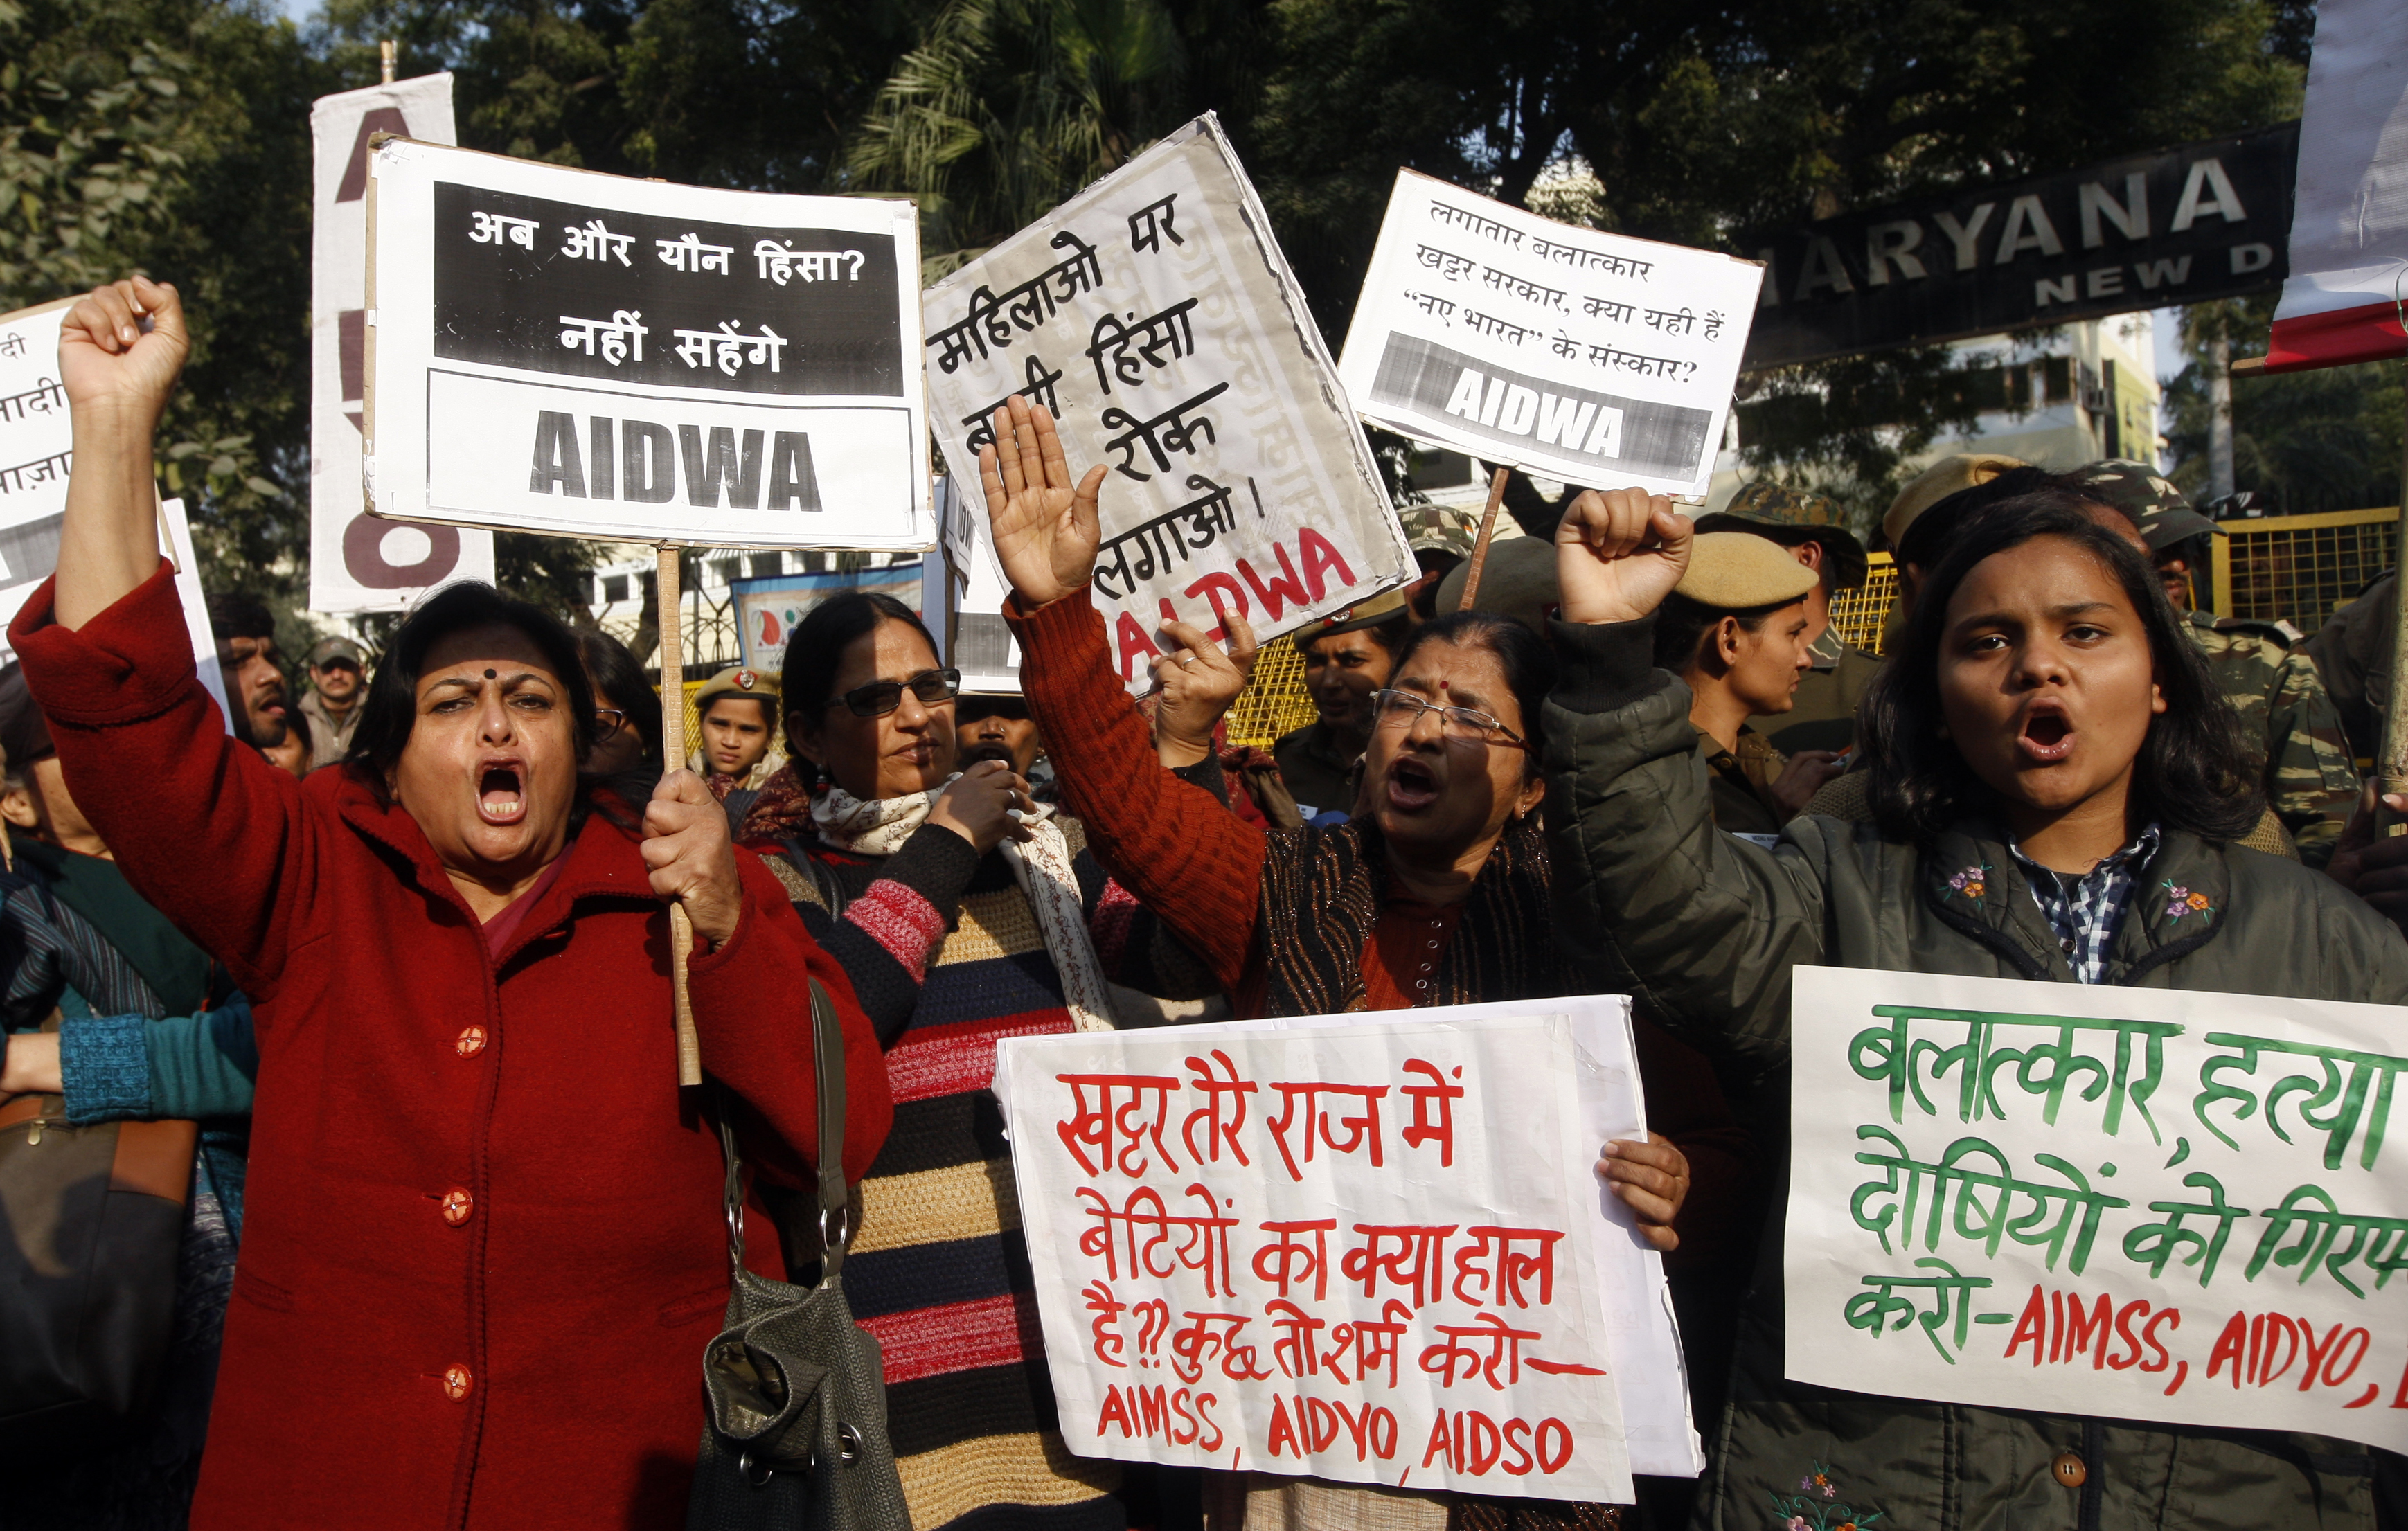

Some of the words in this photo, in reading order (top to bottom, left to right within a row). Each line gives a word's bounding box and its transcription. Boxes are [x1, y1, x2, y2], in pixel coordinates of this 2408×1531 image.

[468, 212, 539, 250] अब
[561, 220, 635, 267] और
[656, 233, 734, 275] यौन
[754, 240, 864, 286] हिंसा?
[925, 231, 1102, 374] महिलाओ
[1128, 194, 1184, 253] पर
[1431, 200, 1526, 250] लगातार
[1533, 237, 1653, 281] बलात्कार
[2035, 255, 2193, 307] NEW
[2231, 242, 2273, 274] D
[1417, 244, 1476, 281] खट्टर
[1483, 267, 1569, 314] सरकार,
[1584, 296, 1636, 323] क्या
[1645, 307, 1697, 336] यही
[1704, 310, 1724, 341] हैं
[560, 310, 648, 366] नहीं
[674, 320, 787, 376] सहेंगे
[1085, 298, 1198, 395] हिंसा
[1465, 309, 1542, 346] भारत”
[1553, 329, 1581, 359] के
[1589, 344, 1697, 382] संस्कार?
[1102, 382, 1229, 481] रोक
[1445, 367, 1624, 458] AIDWA
[530, 411, 822, 512] AIDWA
[1056, 1074, 1181, 1178] खट्टर
[1267, 1082, 1391, 1181] राज
[1401, 1059, 1463, 1167] में
[1076, 1183, 1239, 1298] बेटियों
[1253, 1219, 1337, 1300] का
[1342, 1224, 1459, 1309] क्या
[1453, 1226, 1565, 1309] हाल
[1852, 1125, 2130, 1275] दोषियों
[2125, 1173, 2251, 1287] को
[1265, 1300, 1325, 1377] तो
[1322, 1300, 1413, 1388] शर्म
[2005, 1285, 2188, 1395] AIMSS,
[2207, 1311, 2378, 1408] AIDYO,
[1098, 1384, 1240, 1471] AIMSS,
[1269, 1394, 1409, 1487] AIDYO,
[1423, 1408, 1573, 1476] AIDSO
